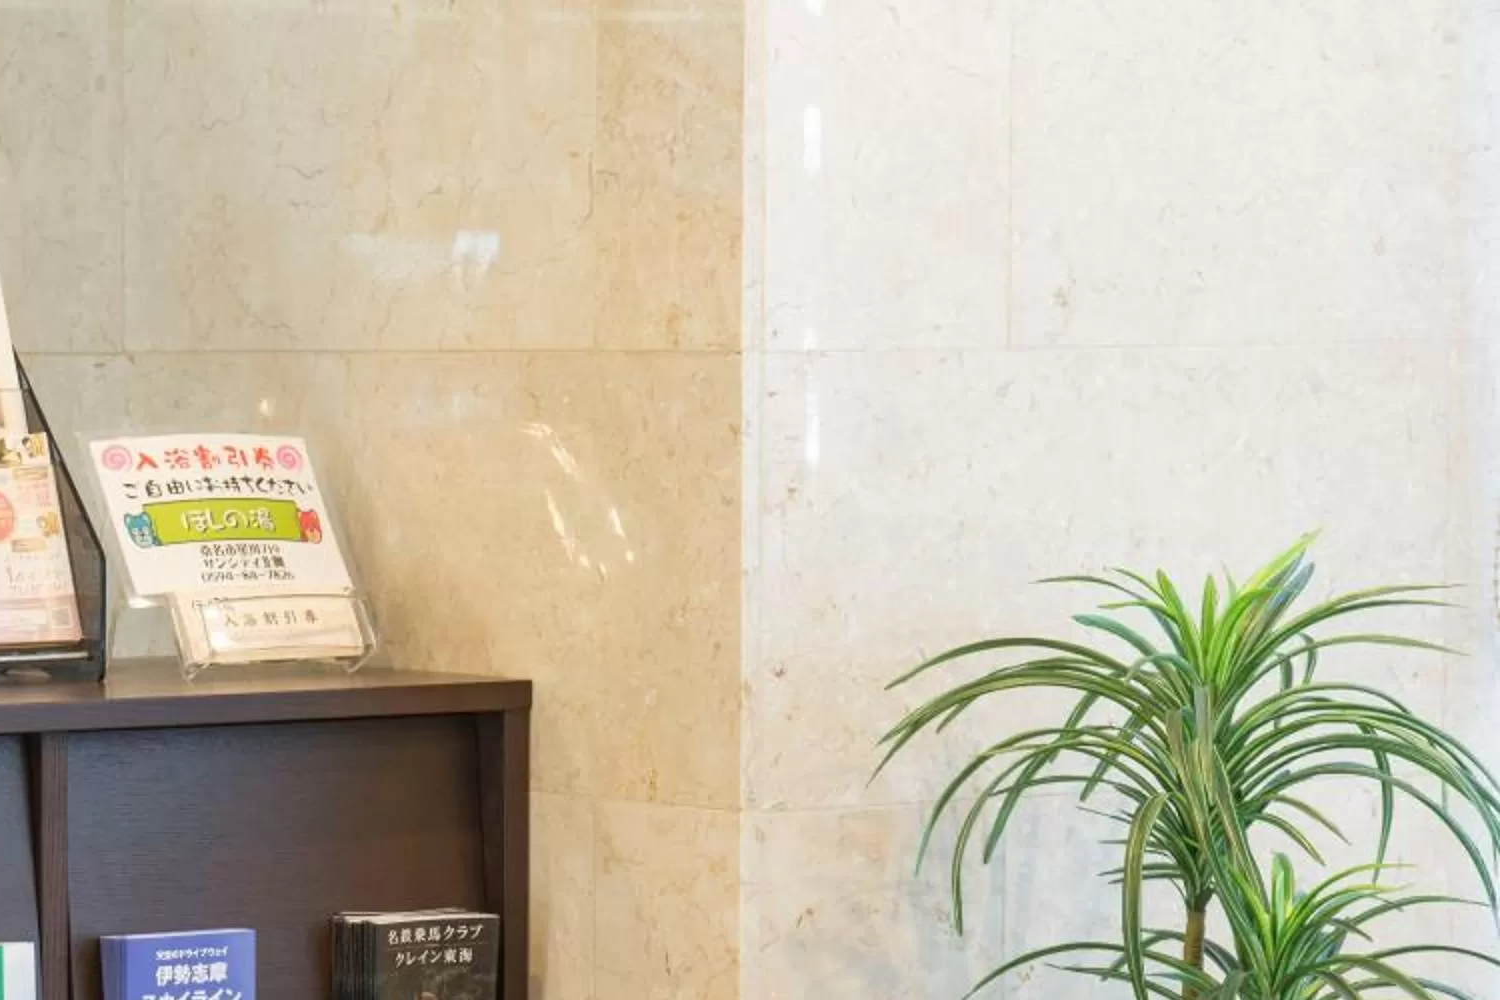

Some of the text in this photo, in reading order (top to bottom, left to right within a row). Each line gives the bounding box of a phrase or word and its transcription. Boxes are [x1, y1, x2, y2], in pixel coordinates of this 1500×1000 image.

[180, 508, 278, 533] ほしの湯
[395, 947, 474, 969] クレイン東海
[155, 961, 229, 987] 伊勢志摩
